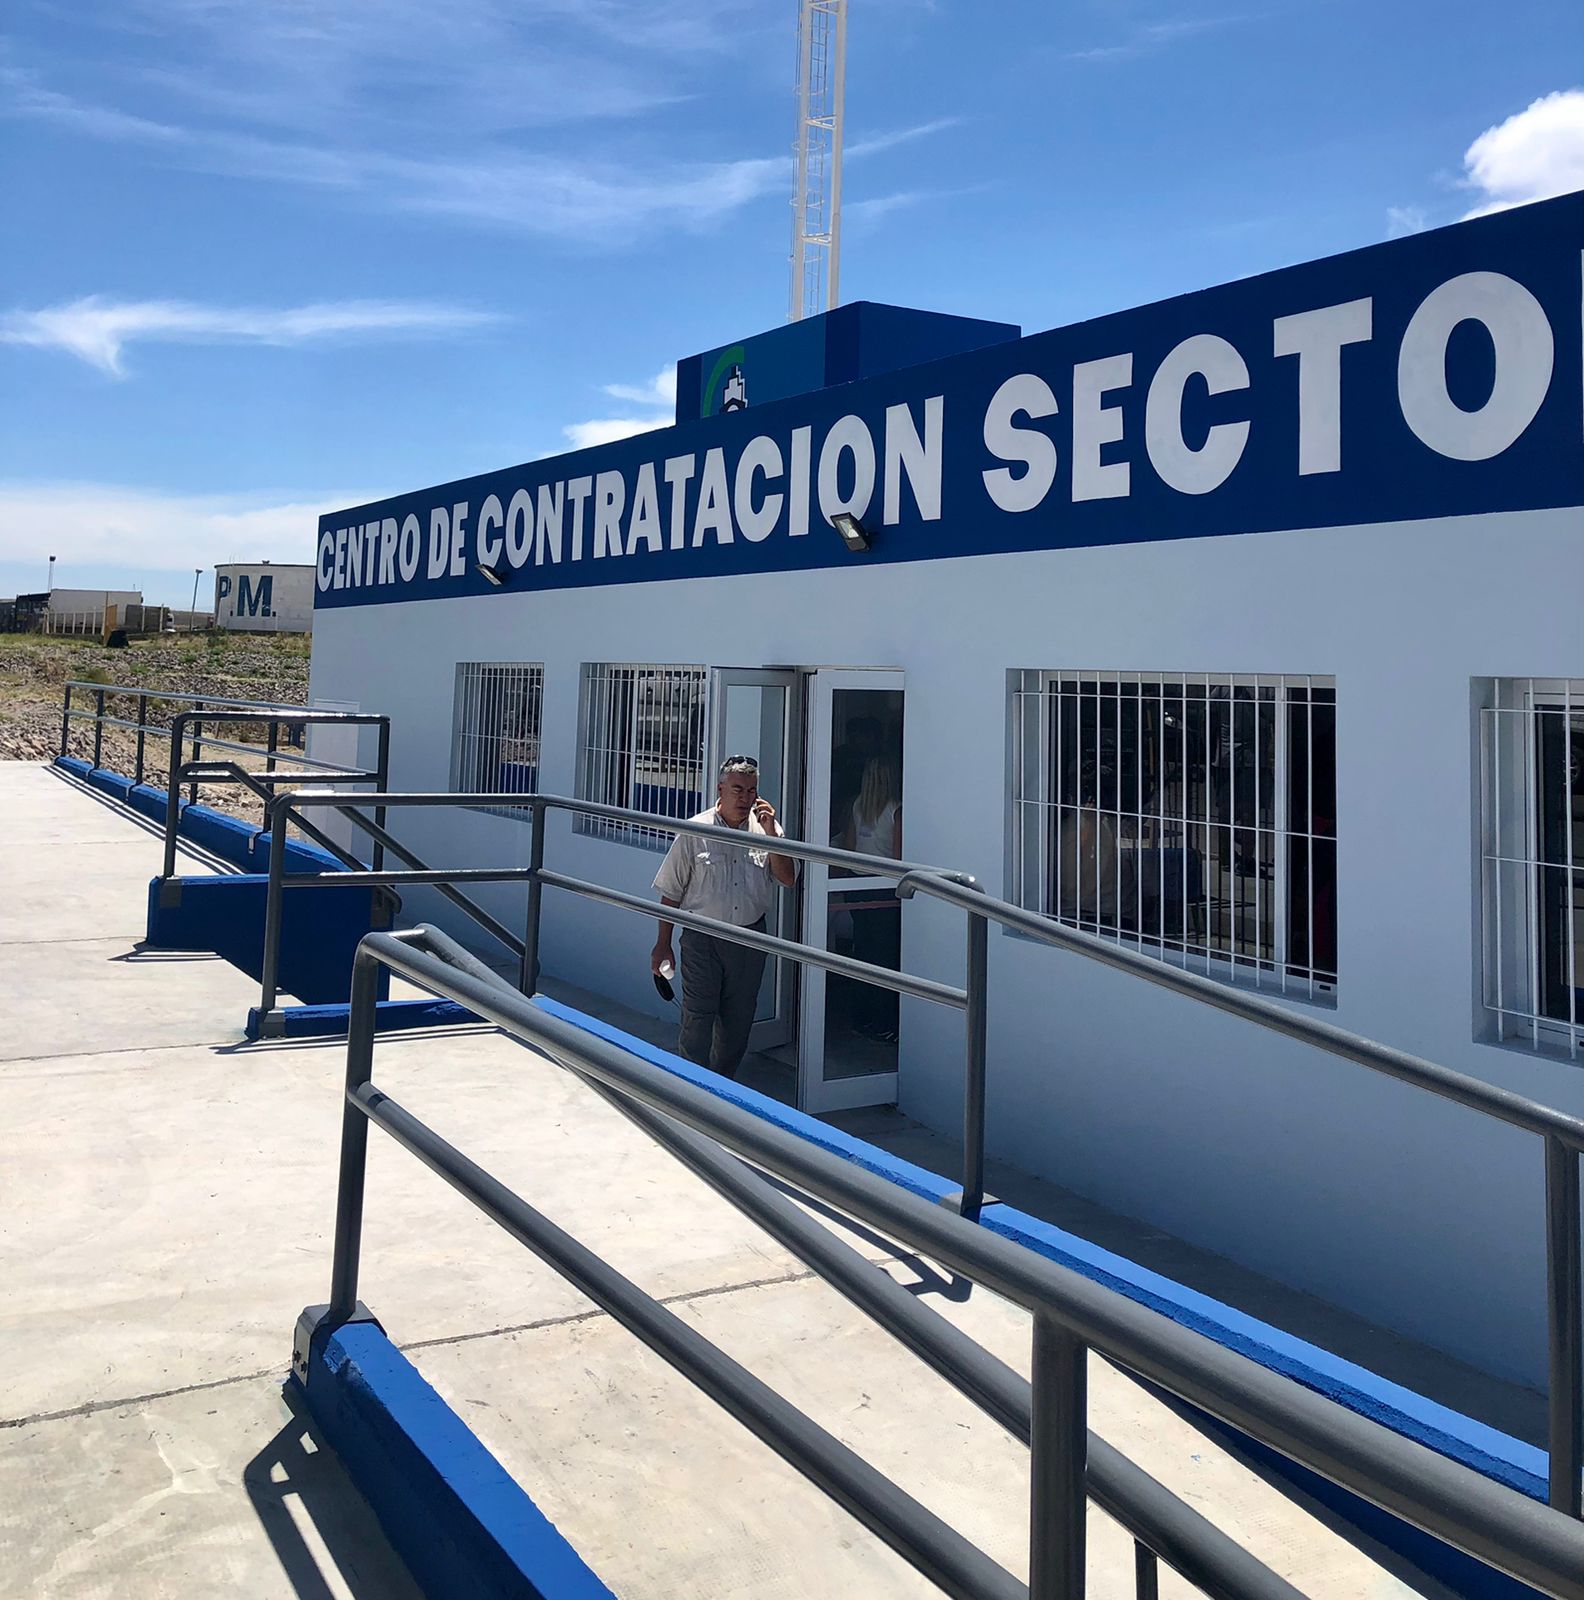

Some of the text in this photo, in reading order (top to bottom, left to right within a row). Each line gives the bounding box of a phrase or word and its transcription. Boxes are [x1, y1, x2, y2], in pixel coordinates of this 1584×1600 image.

[317, 249, 1584, 592] CENTRO DE CONTRATACION SECTO
